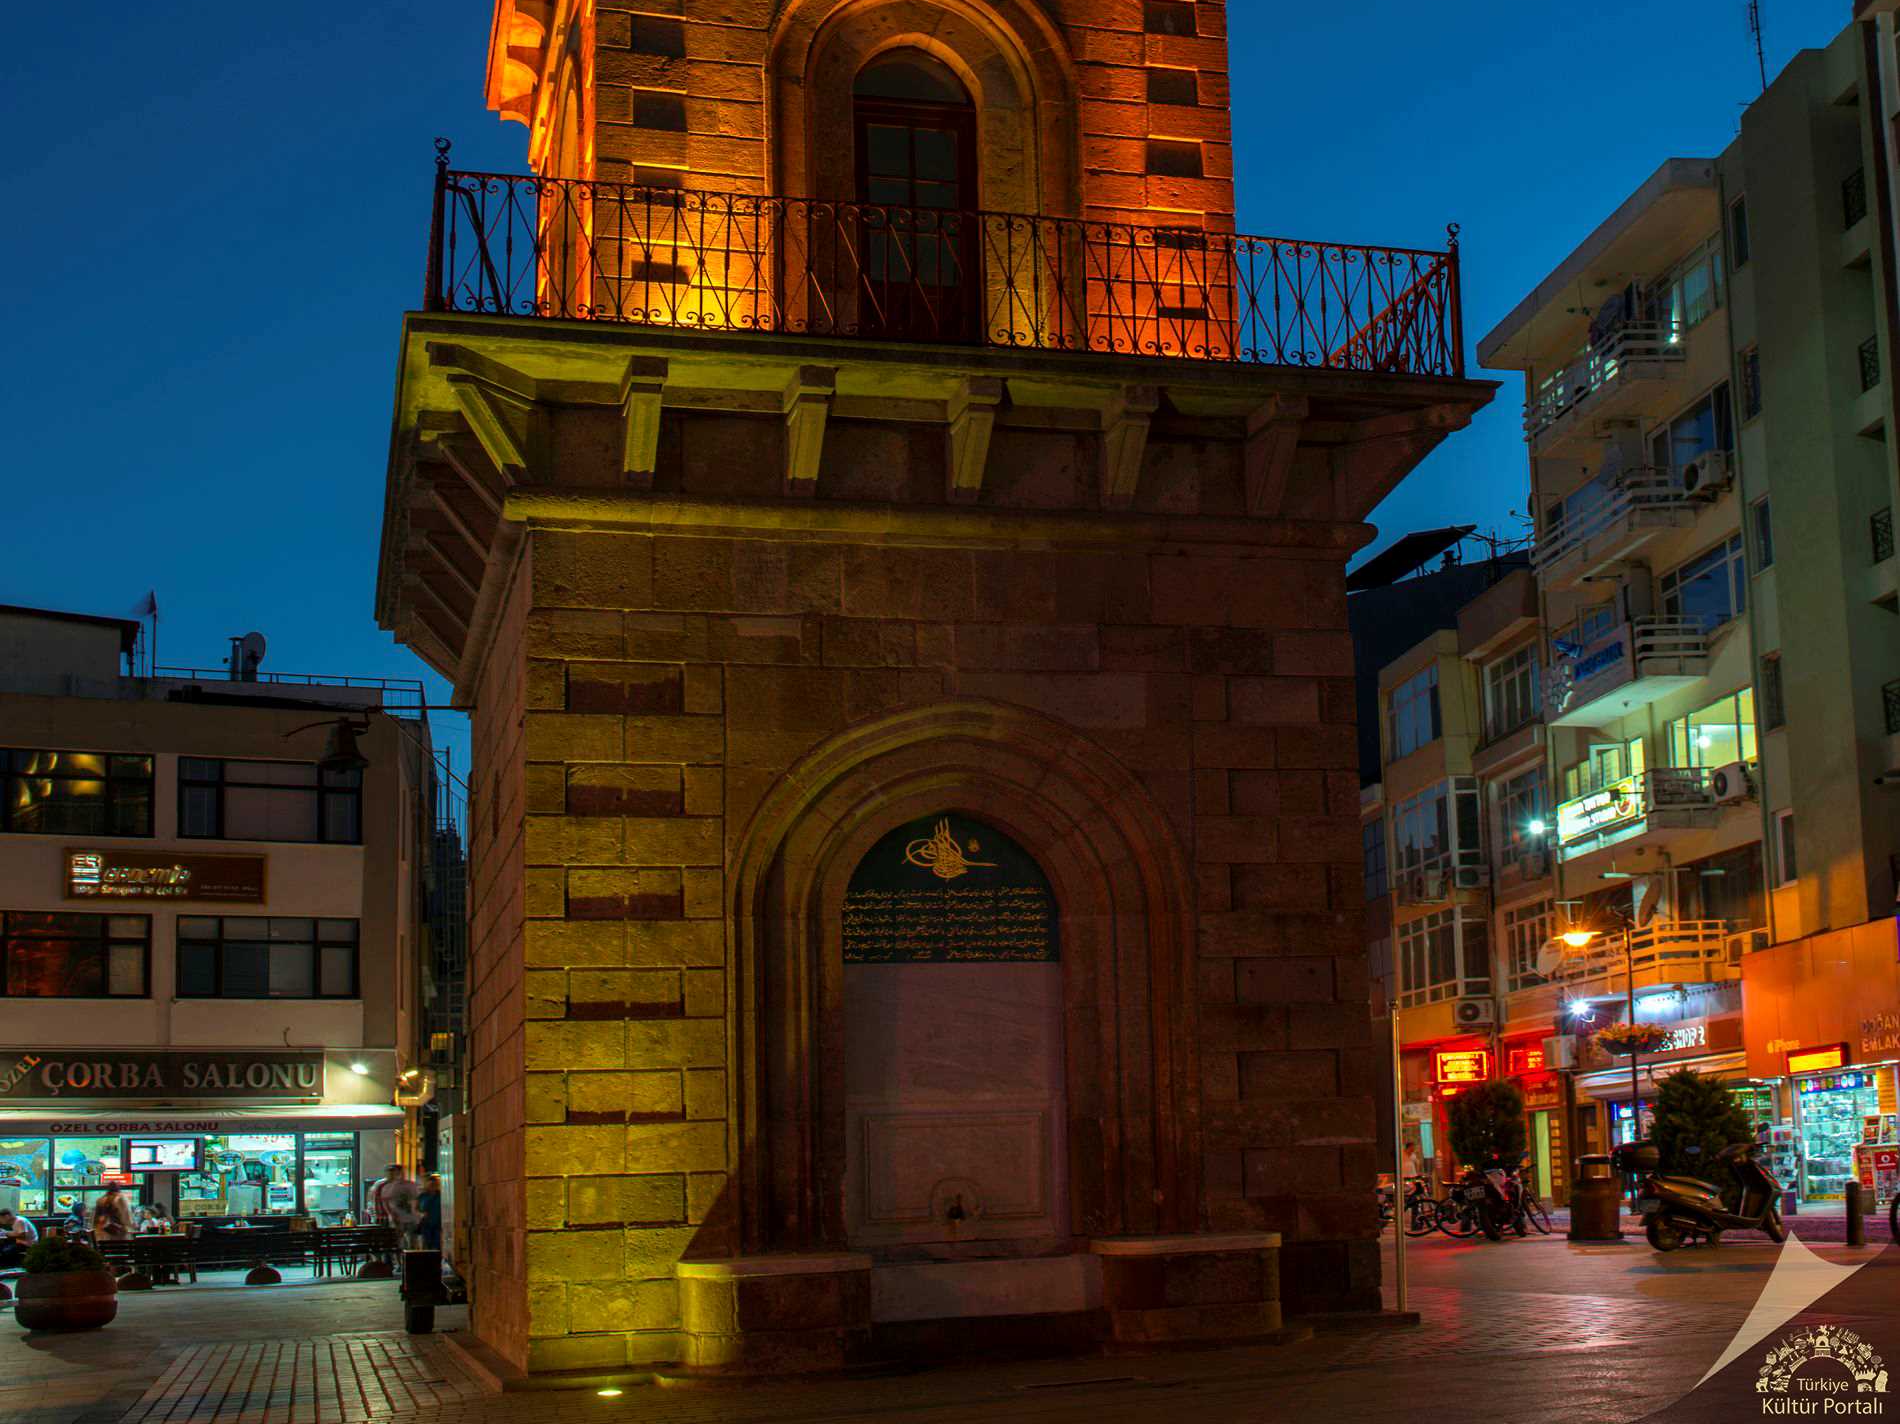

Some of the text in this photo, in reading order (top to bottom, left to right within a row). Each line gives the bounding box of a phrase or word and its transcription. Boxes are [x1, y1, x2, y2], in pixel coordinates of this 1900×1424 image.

[1862, 1033, 1900, 1053] EMLAK
[41, 1062, 318, 1096] ÇORBA SALONU
[154, 1121, 219, 1132] SALONU
